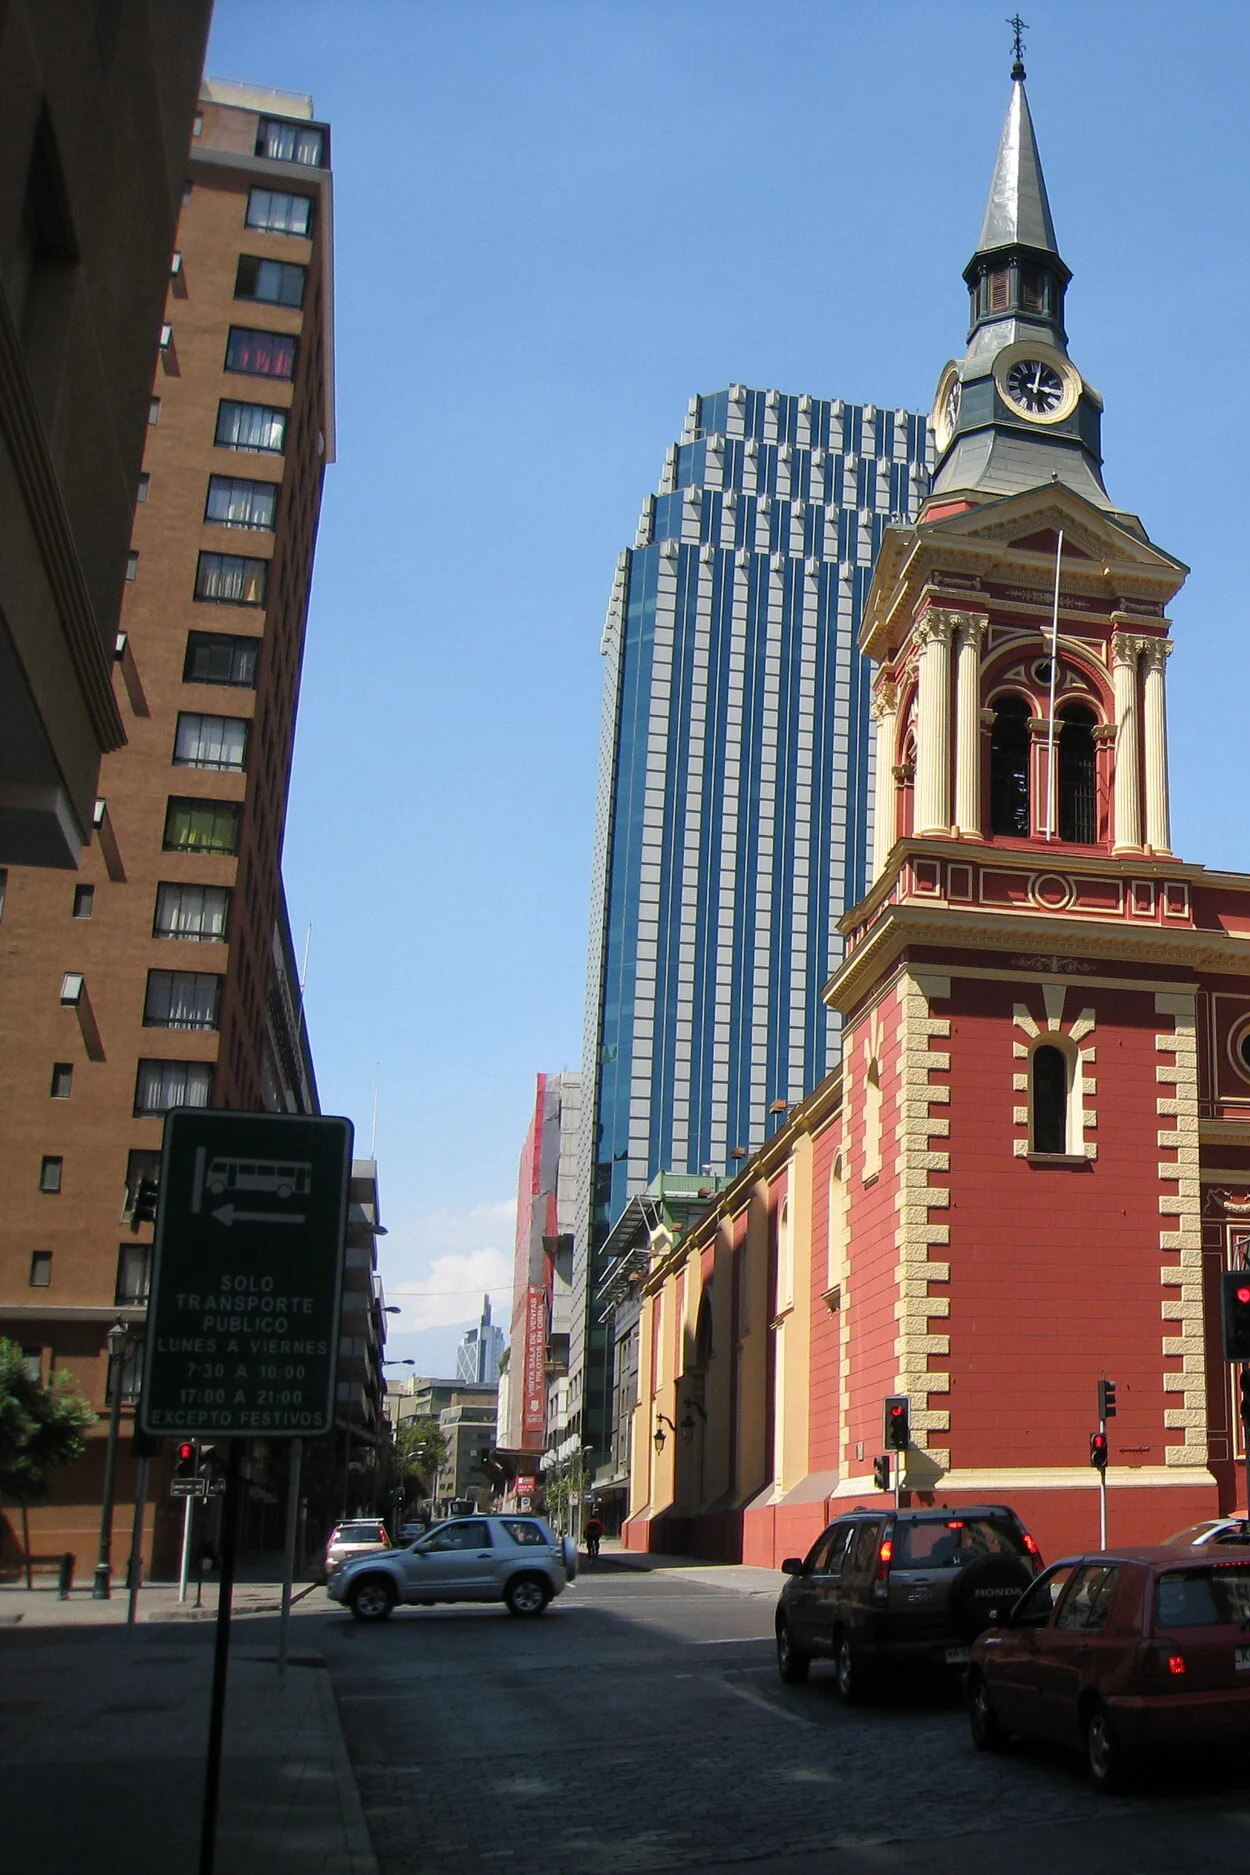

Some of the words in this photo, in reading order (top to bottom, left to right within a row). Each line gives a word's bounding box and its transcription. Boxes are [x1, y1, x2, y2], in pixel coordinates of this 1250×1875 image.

[176, 1294, 314, 1314] TRANSPORTE
[203, 1316, 289, 1333] PUBLICO
[157, 1337, 217, 1353] LUNES
[226, 1339, 239, 1353] A
[250, 1339, 328, 1355] VIERNES
[234, 1364, 248, 1379] A
[260, 1365, 305, 1380] 10:00
[179, 1388, 225, 1404] 17:00
[233, 1389, 246, 1404] A
[256, 1390, 303, 1405] 21:00
[151, 1409, 232, 1426] EXCEPTO
[240, 1411, 323, 1426] FESTIVOS
[974, 1588, 1023, 1597] HONDA
